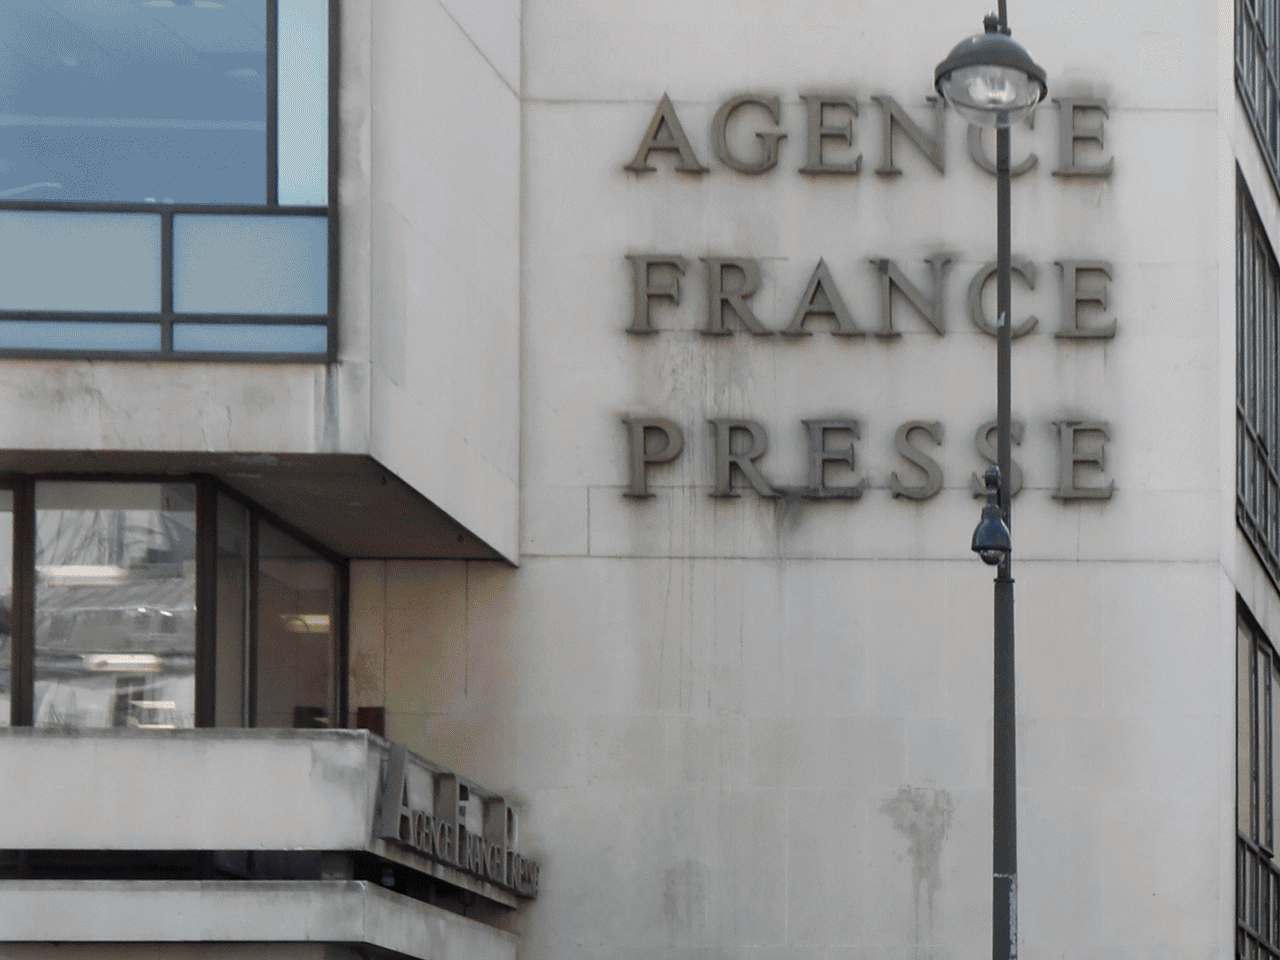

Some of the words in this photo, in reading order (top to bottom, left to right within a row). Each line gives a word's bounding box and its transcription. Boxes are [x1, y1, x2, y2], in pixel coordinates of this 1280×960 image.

[623, 91, 1115, 177] AGENCE
[624, 254, 1118, 339] FRANCE
[622, 416, 1116, 501] PRESSE
